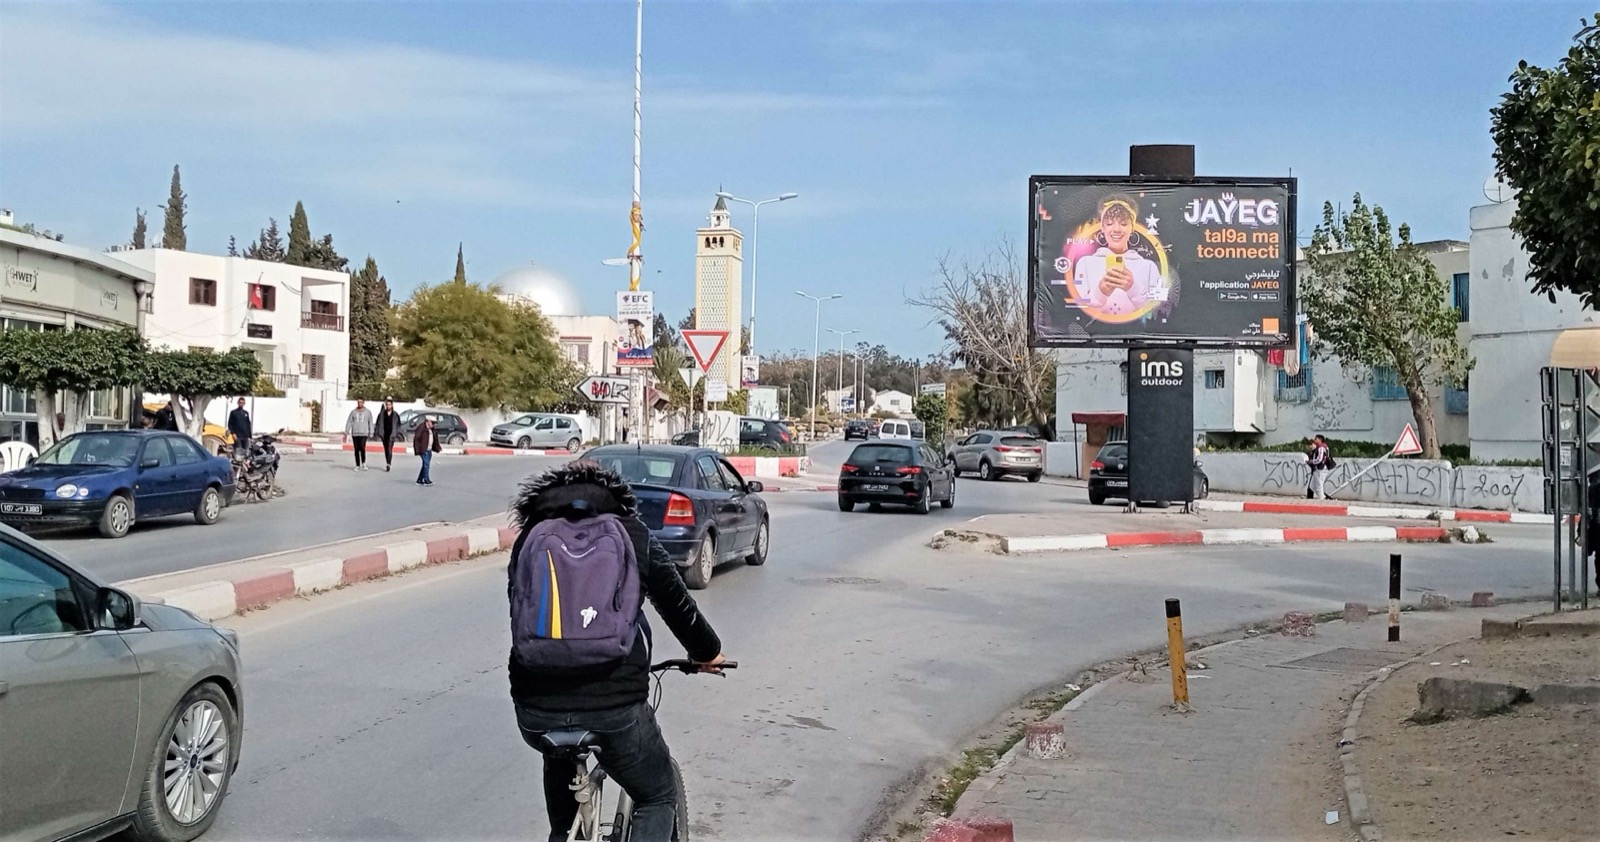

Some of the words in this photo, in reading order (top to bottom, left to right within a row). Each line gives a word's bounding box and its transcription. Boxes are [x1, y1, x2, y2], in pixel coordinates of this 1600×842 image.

[1184, 197, 1280, 226] JAYEG
[1204, 229, 1247, 243] tal9a
[1252, 232, 1279, 243] ma
[1197, 244, 1279, 258] tconnecti
[1200, 280, 1250, 290] l'application
[1251, 281, 1280, 289] JAYEG
[632, 295, 648, 303] EFC
[1140, 352, 1183, 377] ims
[1141, 378, 1183, 386] outdoor
[1471, 474, 1525, 508] 2007
